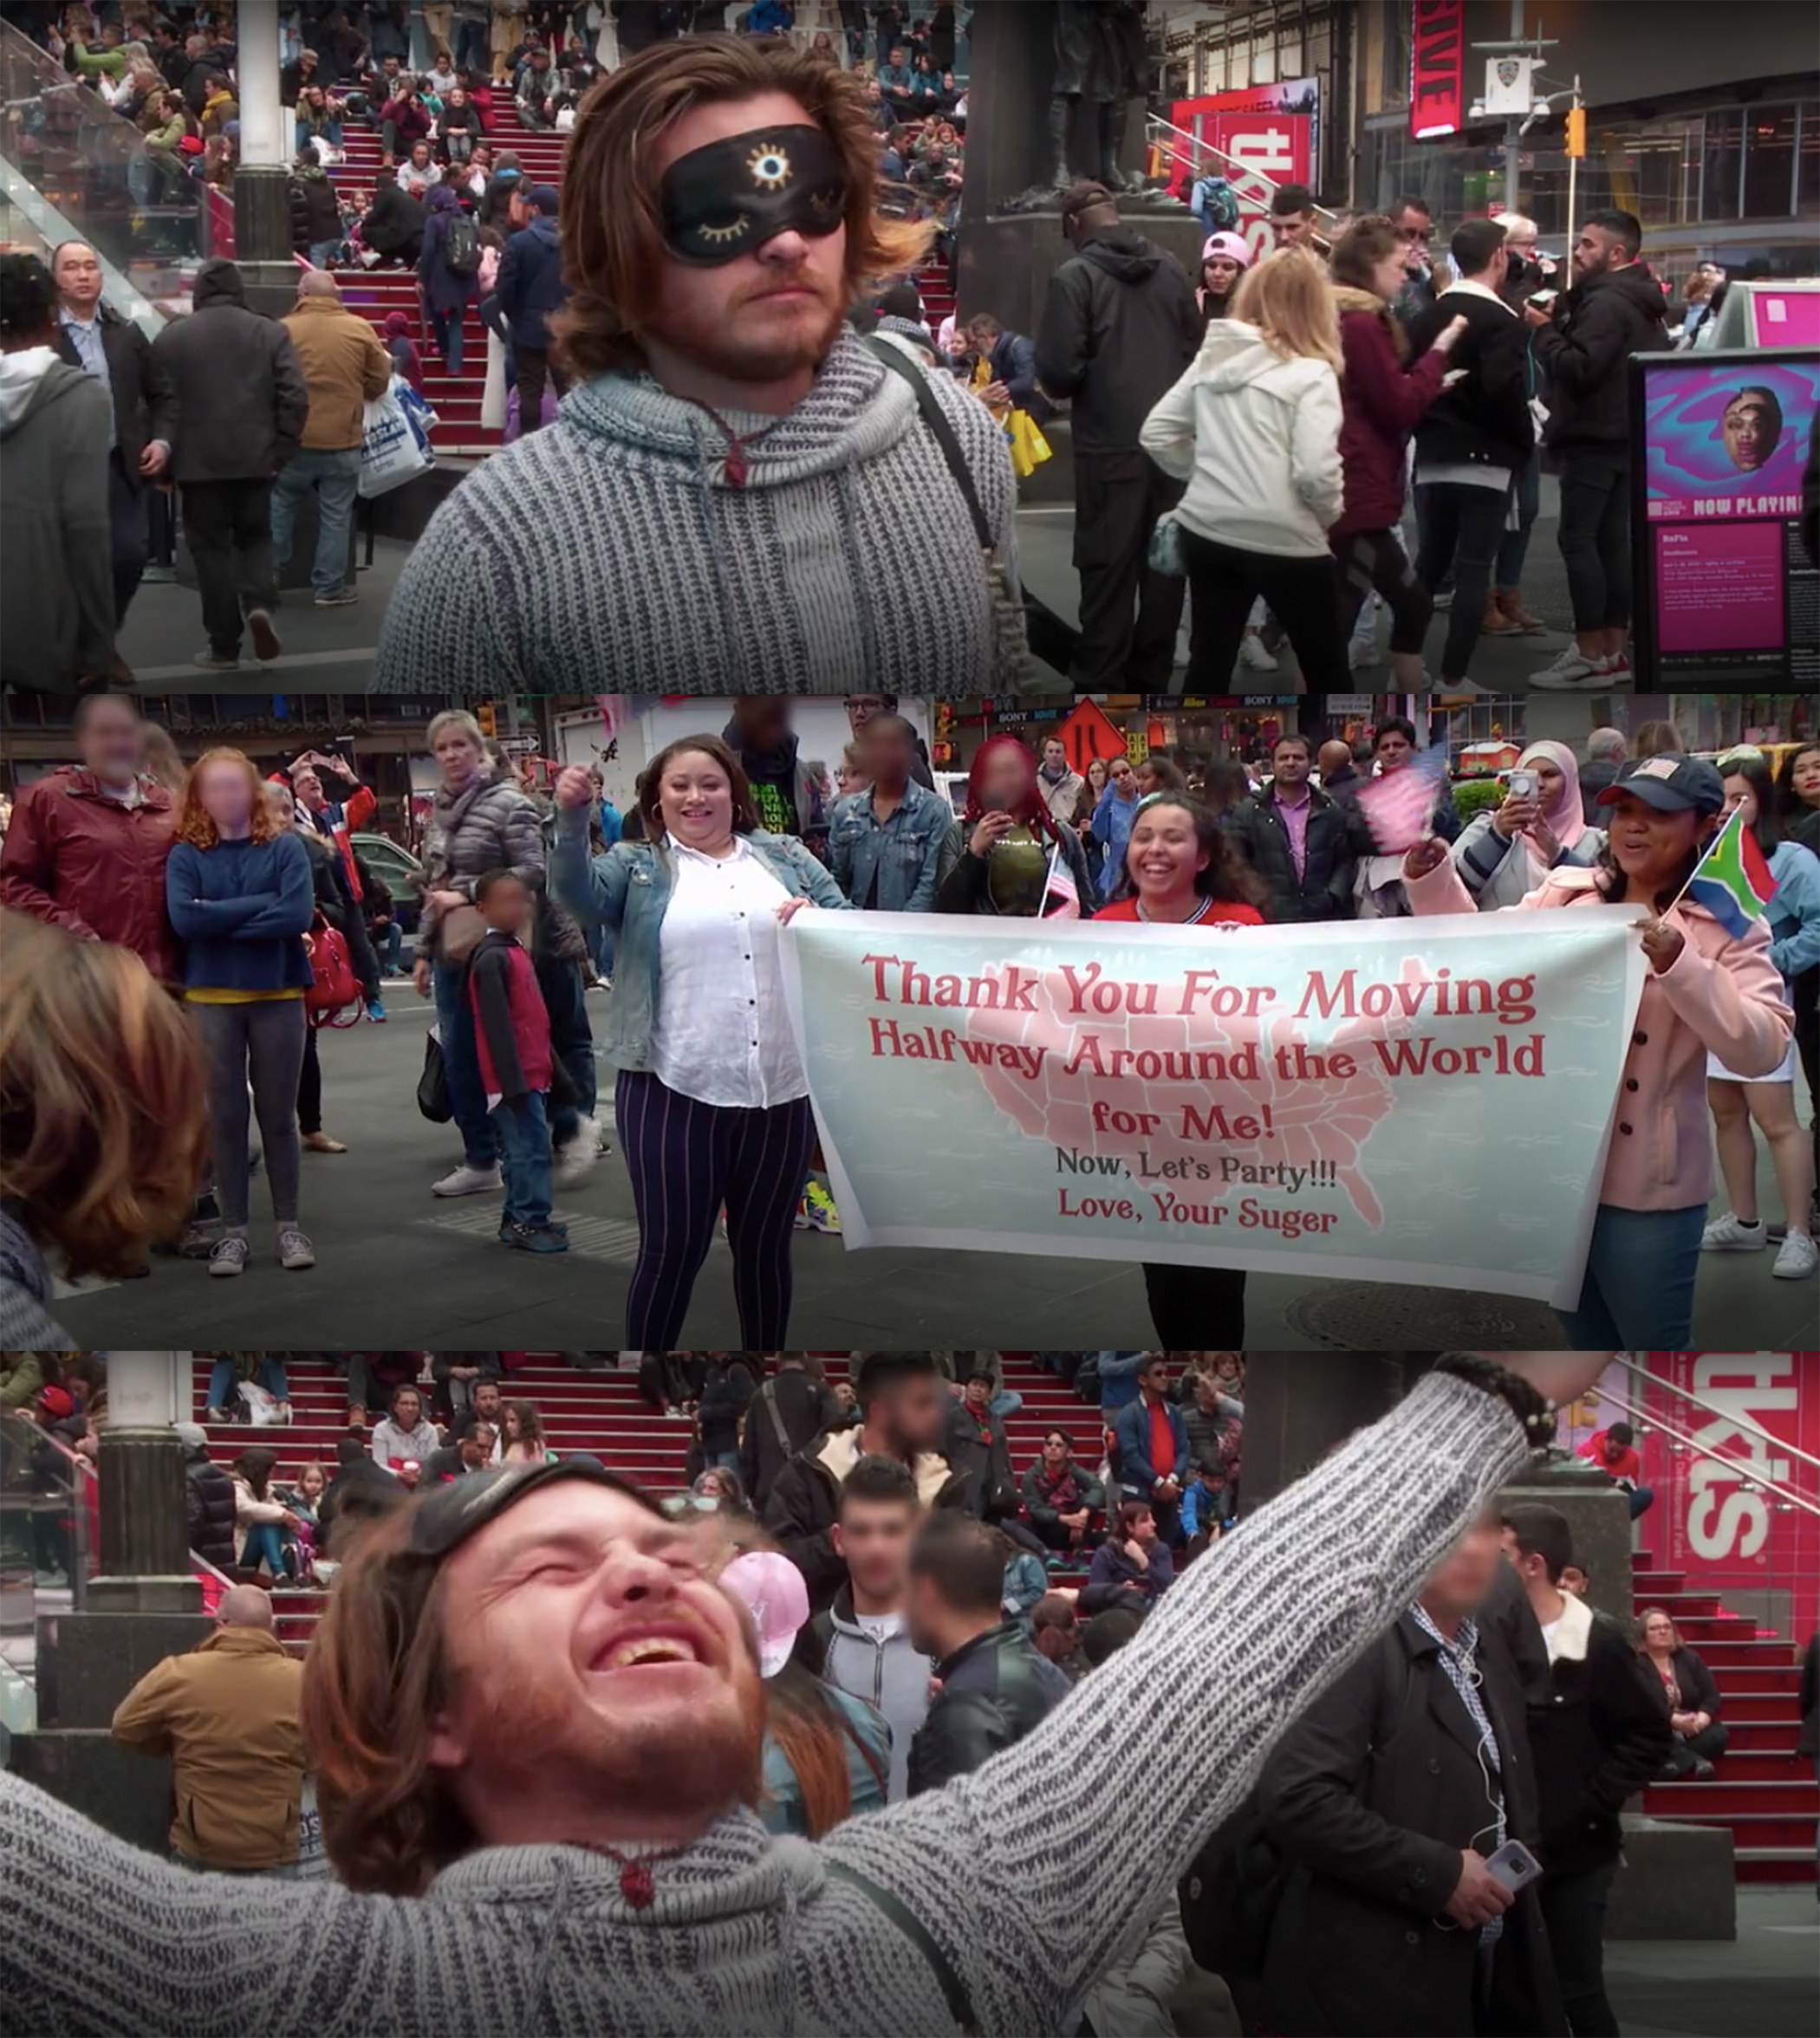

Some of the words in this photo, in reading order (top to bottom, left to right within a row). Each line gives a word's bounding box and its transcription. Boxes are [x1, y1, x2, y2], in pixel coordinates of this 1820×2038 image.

[1693, 498, 1731, 516] NOW
[998, 711, 1028, 723] SONY
[1245, 696, 1272, 705] SONY
[861, 954, 1039, 1012] Thank
[1059, 962, 1158, 1015] You
[1176, 969, 1276, 1017] For
[1292, 968, 1536, 1024] Moving
[868, 1018, 1047, 1080] Halfway
[1063, 1035, 1260, 1081] Around
[1275, 1042, 1356, 1081] the
[1372, 1035, 1545, 1077] World
[1093, 1101, 1160, 1136] for
[1180, 1104, 1275, 1140] Me!
[1056, 1147, 1131, 1179] Now,
[1139, 1152, 1211, 1179] Let's
[1220, 1158, 1336, 1193] Party!!!
[1059, 1189, 1142, 1223] Love,
[1152, 1192, 1228, 1225] Your
[1238, 1198, 1337, 1238] Suger
[1687, 1351, 1797, 1560] tkts
